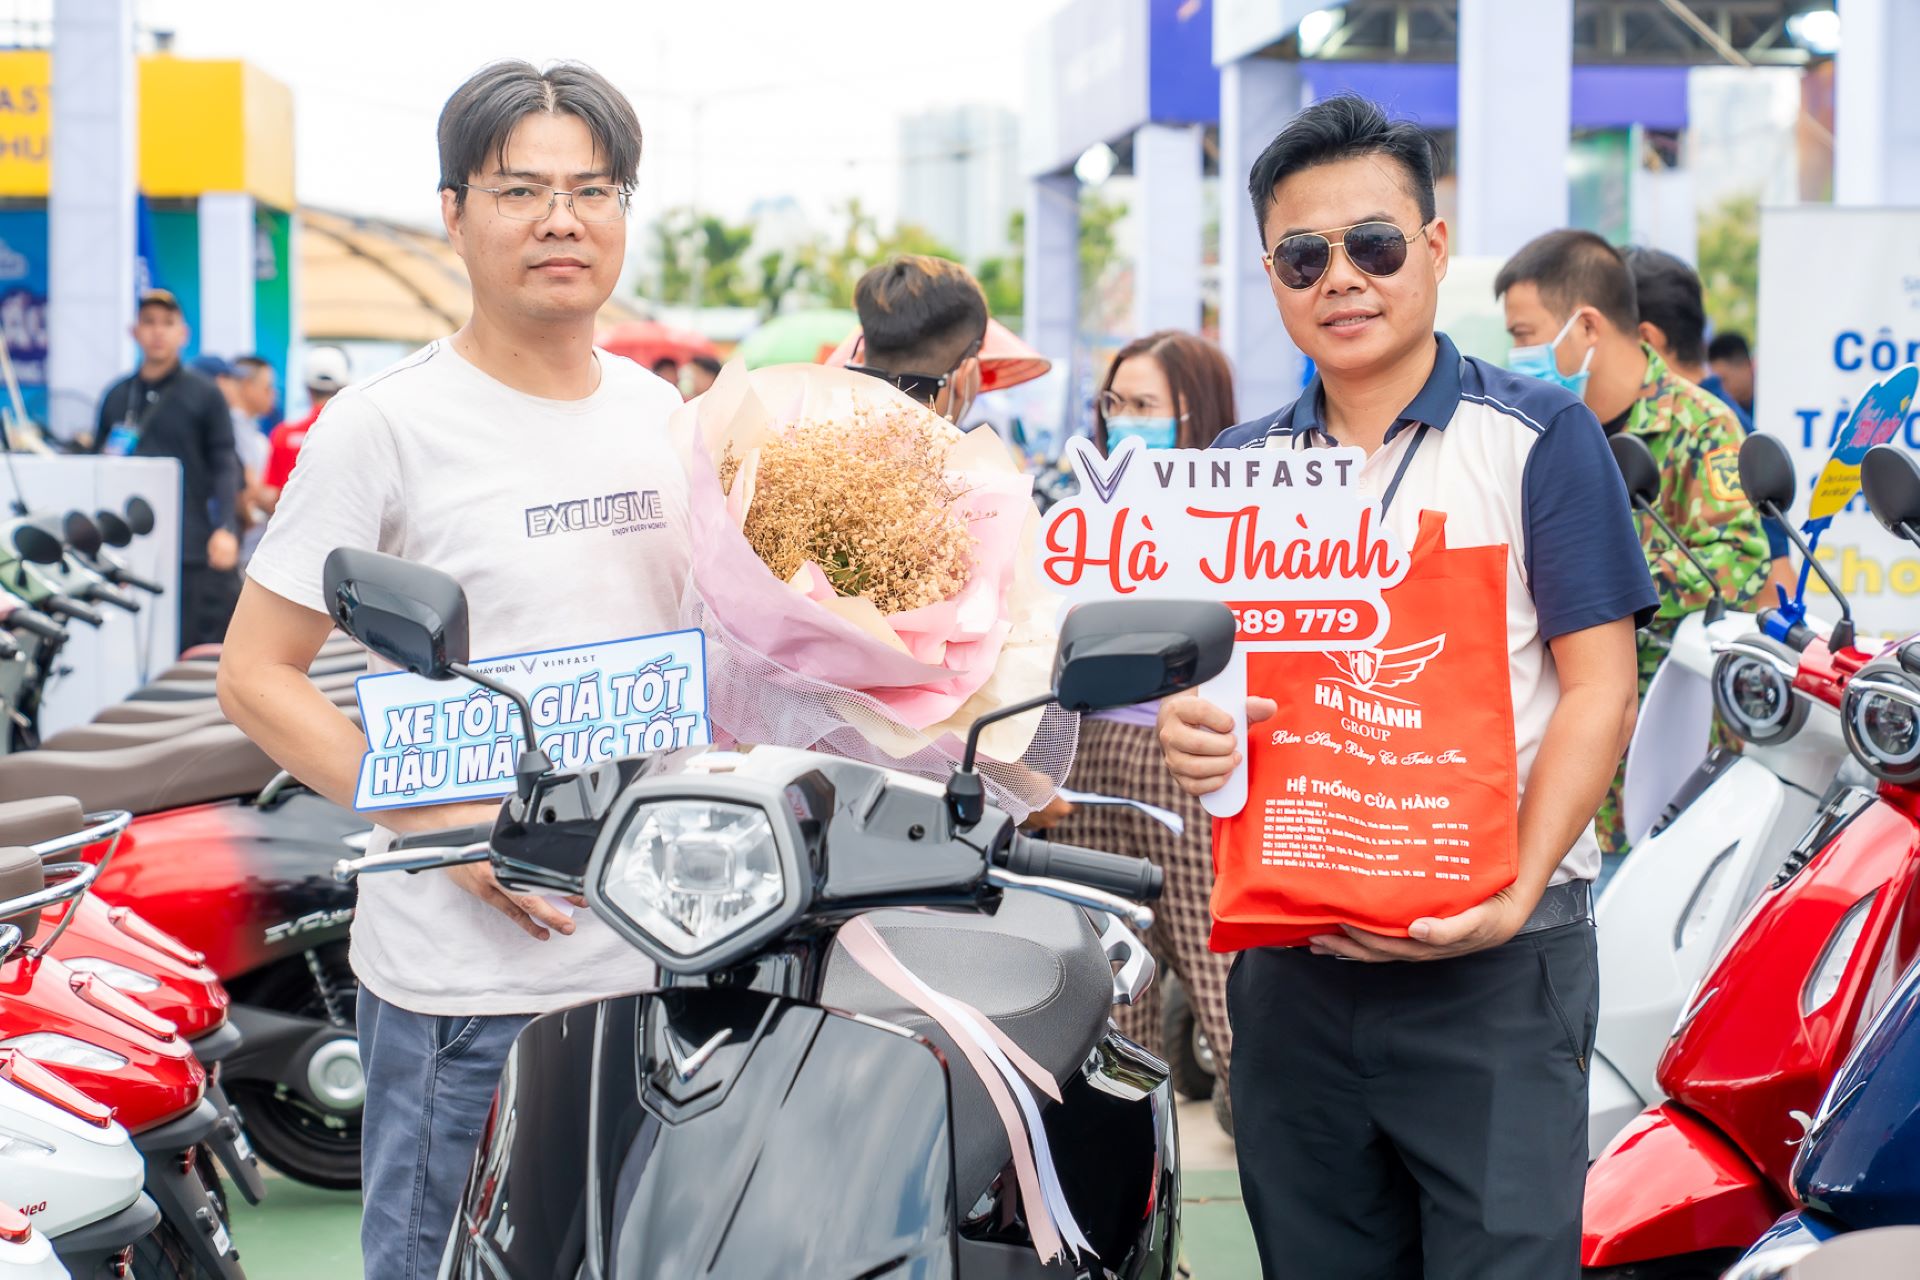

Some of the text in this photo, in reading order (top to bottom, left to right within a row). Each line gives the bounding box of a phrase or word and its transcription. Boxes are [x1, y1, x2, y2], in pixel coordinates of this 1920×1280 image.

[1154, 460, 1353, 488] VINFAST
[525, 490, 663, 538] EXCLUSIVE
[1043, 506, 1400, 593] Hà Thành
[1295, 609, 1358, 633] 779
[543, 655, 596, 667] VINFAST
[385, 704, 434, 748] XE
[612, 655, 687, 716] TỐT
[1314, 684, 1422, 729] HÀ THÀNH
[1340, 717, 1391, 742] GROUP
[373, 746, 448, 795] HẬU
[624, 705, 696, 756] TỐT
[1436, 749, 1467, 764] Tim
[1286, 775, 1450, 810] HỆ THỐNG CỬA HÀNG
